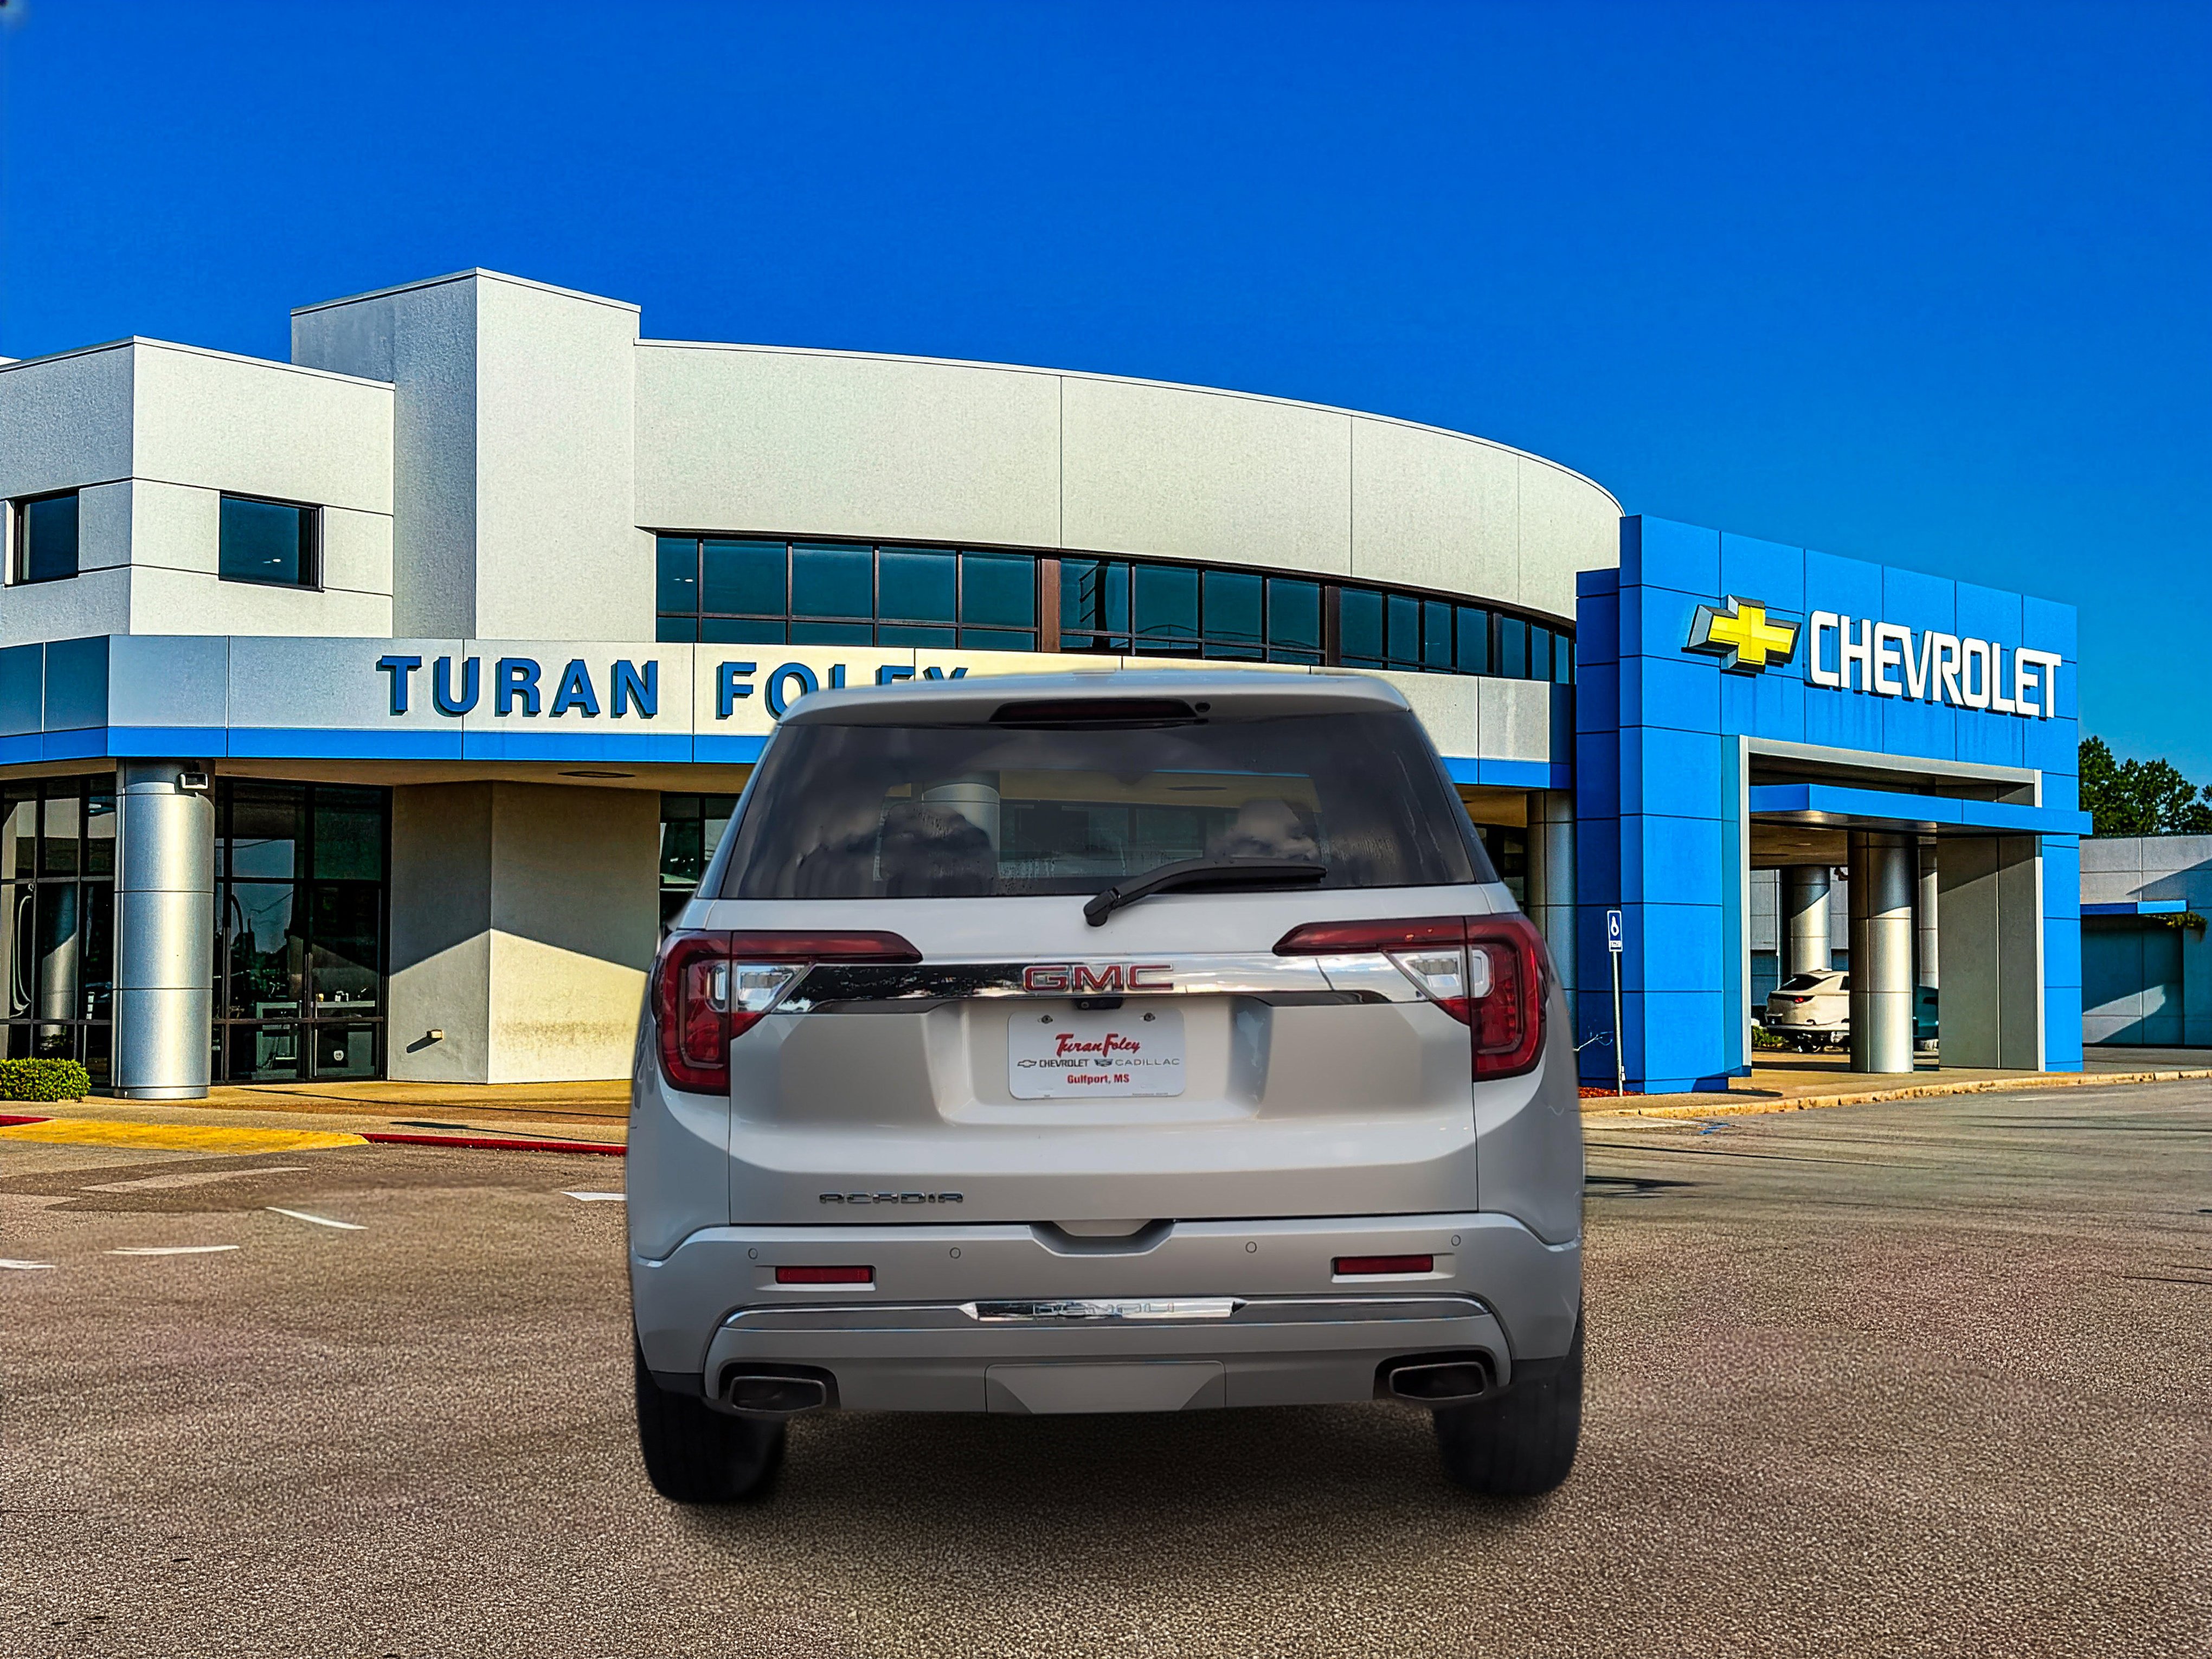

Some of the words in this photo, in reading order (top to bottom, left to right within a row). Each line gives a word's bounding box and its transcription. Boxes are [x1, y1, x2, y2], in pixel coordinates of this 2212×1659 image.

[1810, 610, 2062, 718] CHEVROLET
[376, 655, 658, 719] TURAN
[1022, 964, 1174, 992] GMC
[1039, 1058, 1088, 1068] CHEVROLET
[1067, 1074, 1111, 1084] Gulfport,
[1114, 1074, 1129, 1083] MS
[819, 1192, 963, 1204] ACADIA
